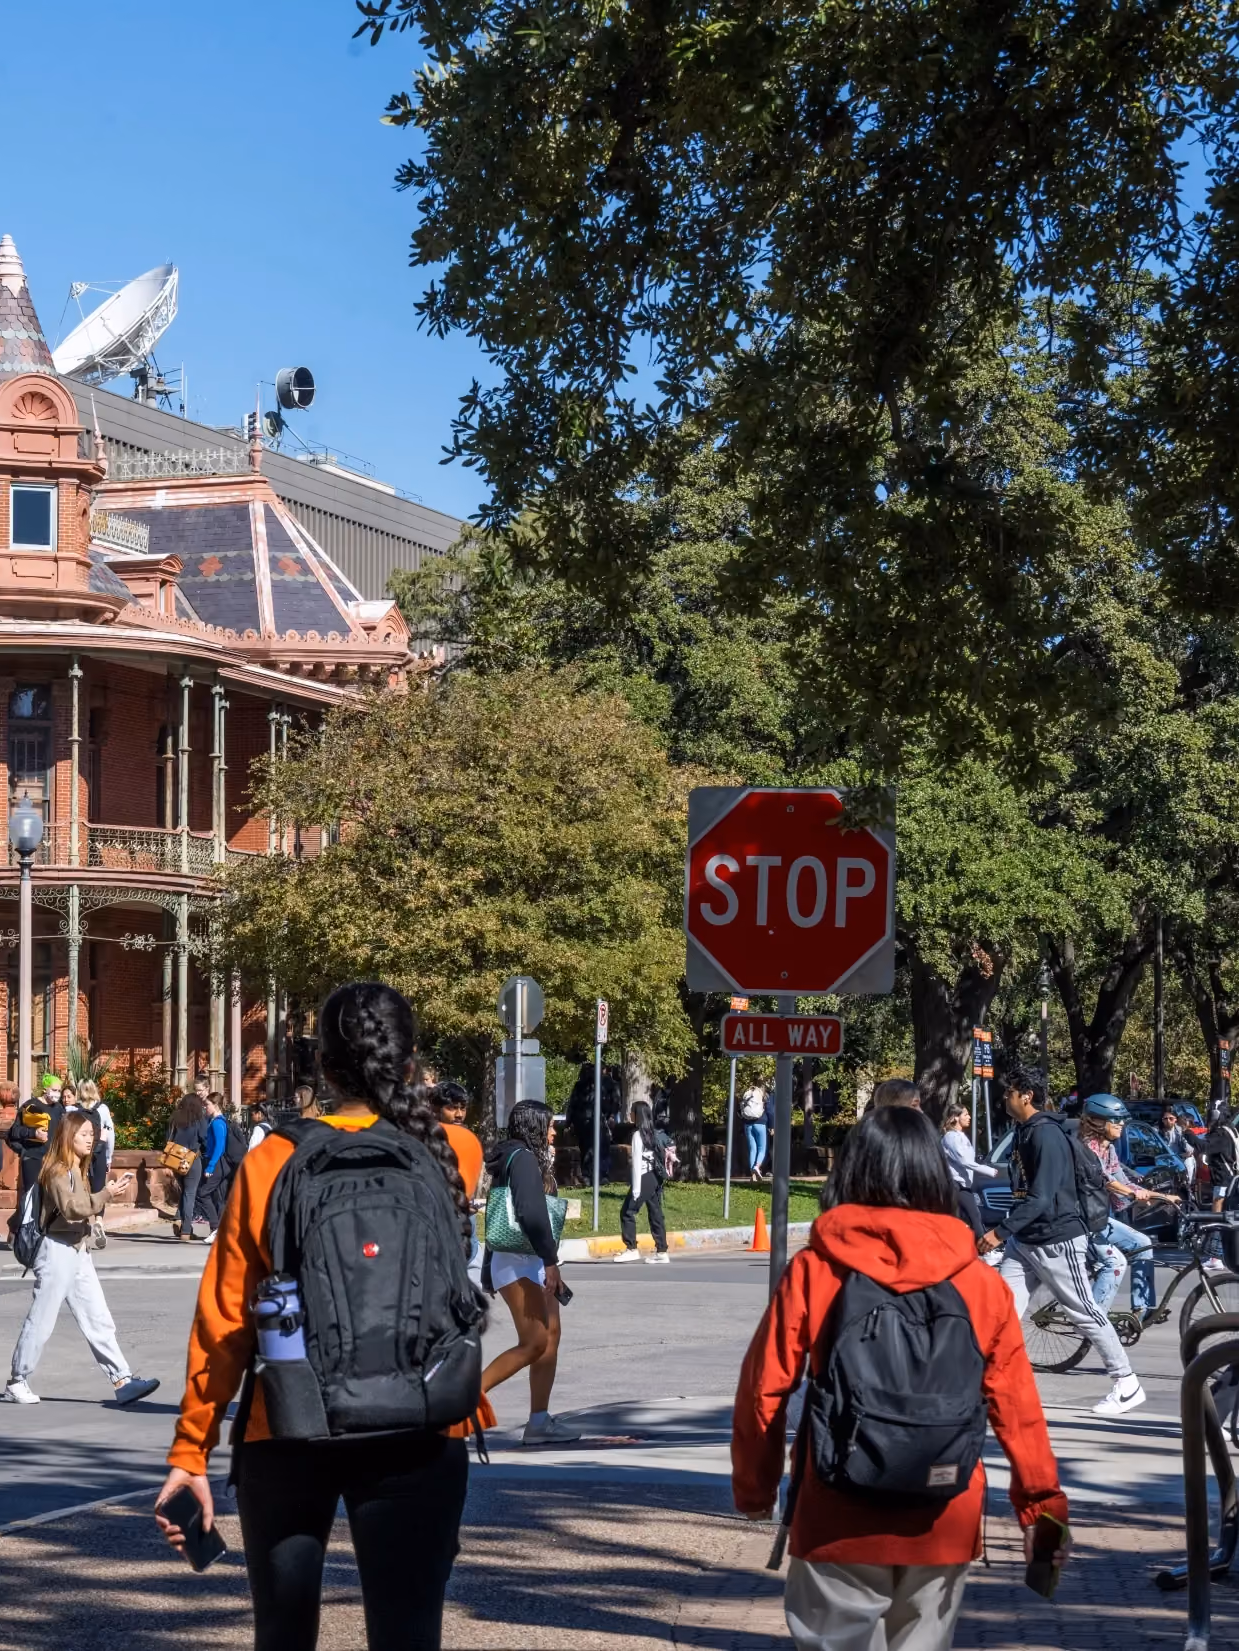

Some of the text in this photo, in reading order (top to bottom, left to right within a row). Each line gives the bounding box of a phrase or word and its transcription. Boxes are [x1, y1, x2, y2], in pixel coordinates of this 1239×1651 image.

[700, 854, 876, 928] STOP
[732, 1023, 832, 1048] ALL WAY
